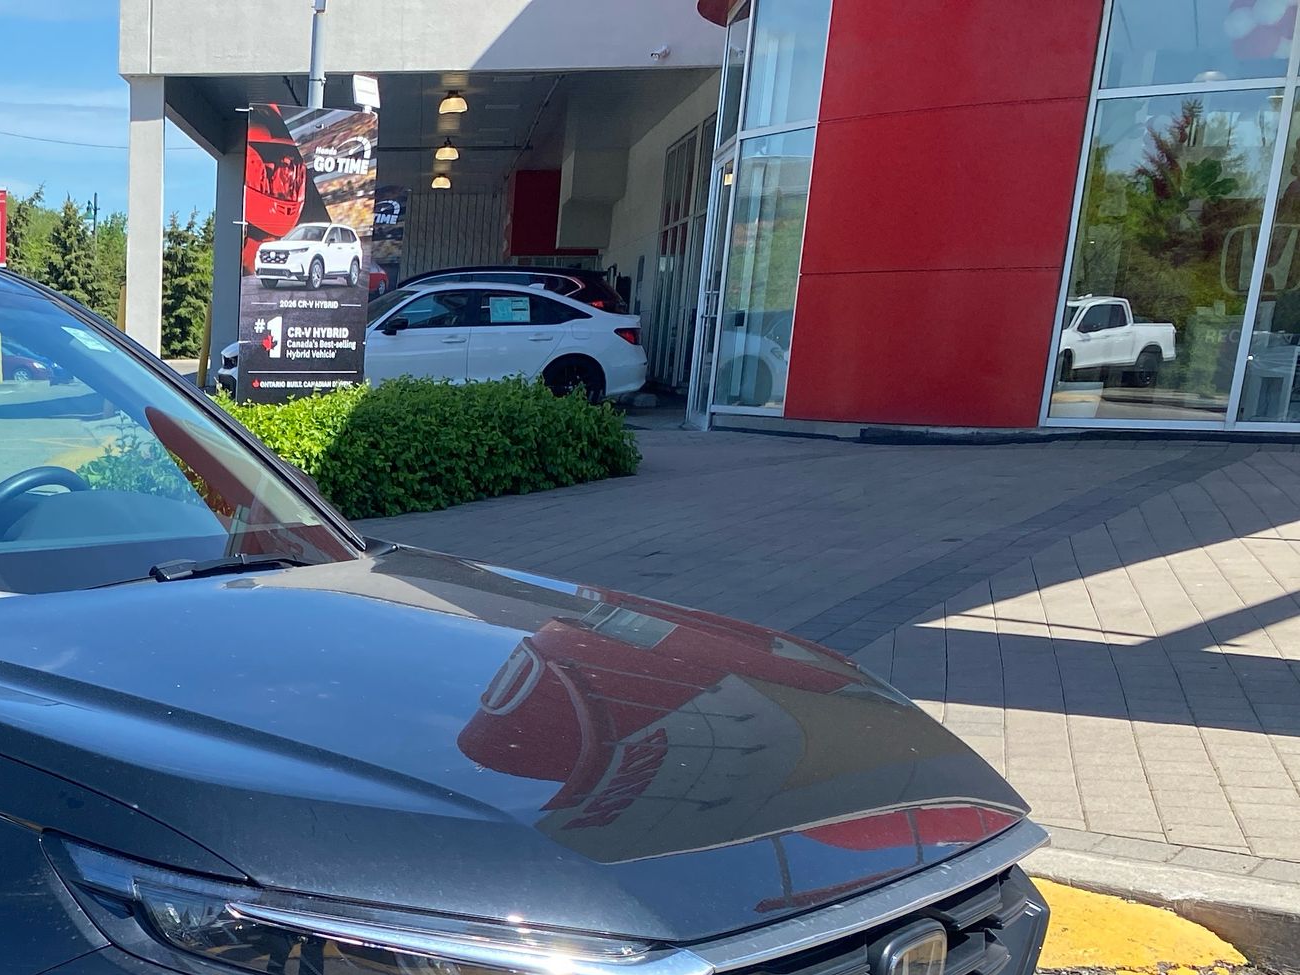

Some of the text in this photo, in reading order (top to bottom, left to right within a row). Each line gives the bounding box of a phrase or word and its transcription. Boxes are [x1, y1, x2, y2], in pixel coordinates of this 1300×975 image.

[315, 146, 337, 155] Honda
[313, 155, 370, 175] GO TIME
[374, 213, 398, 225] IME
[298, 300, 314, 309] CR-V
[314, 300, 339, 309] HYBRID
[287, 327, 349, 339] CR-V HYBRID
[286, 339, 357, 351] Canada's Best-selling
[286, 349, 310, 360] Hybrid
[260, 380, 285, 388] ONTARIO
[303, 380, 331, 388] CANADIAN
